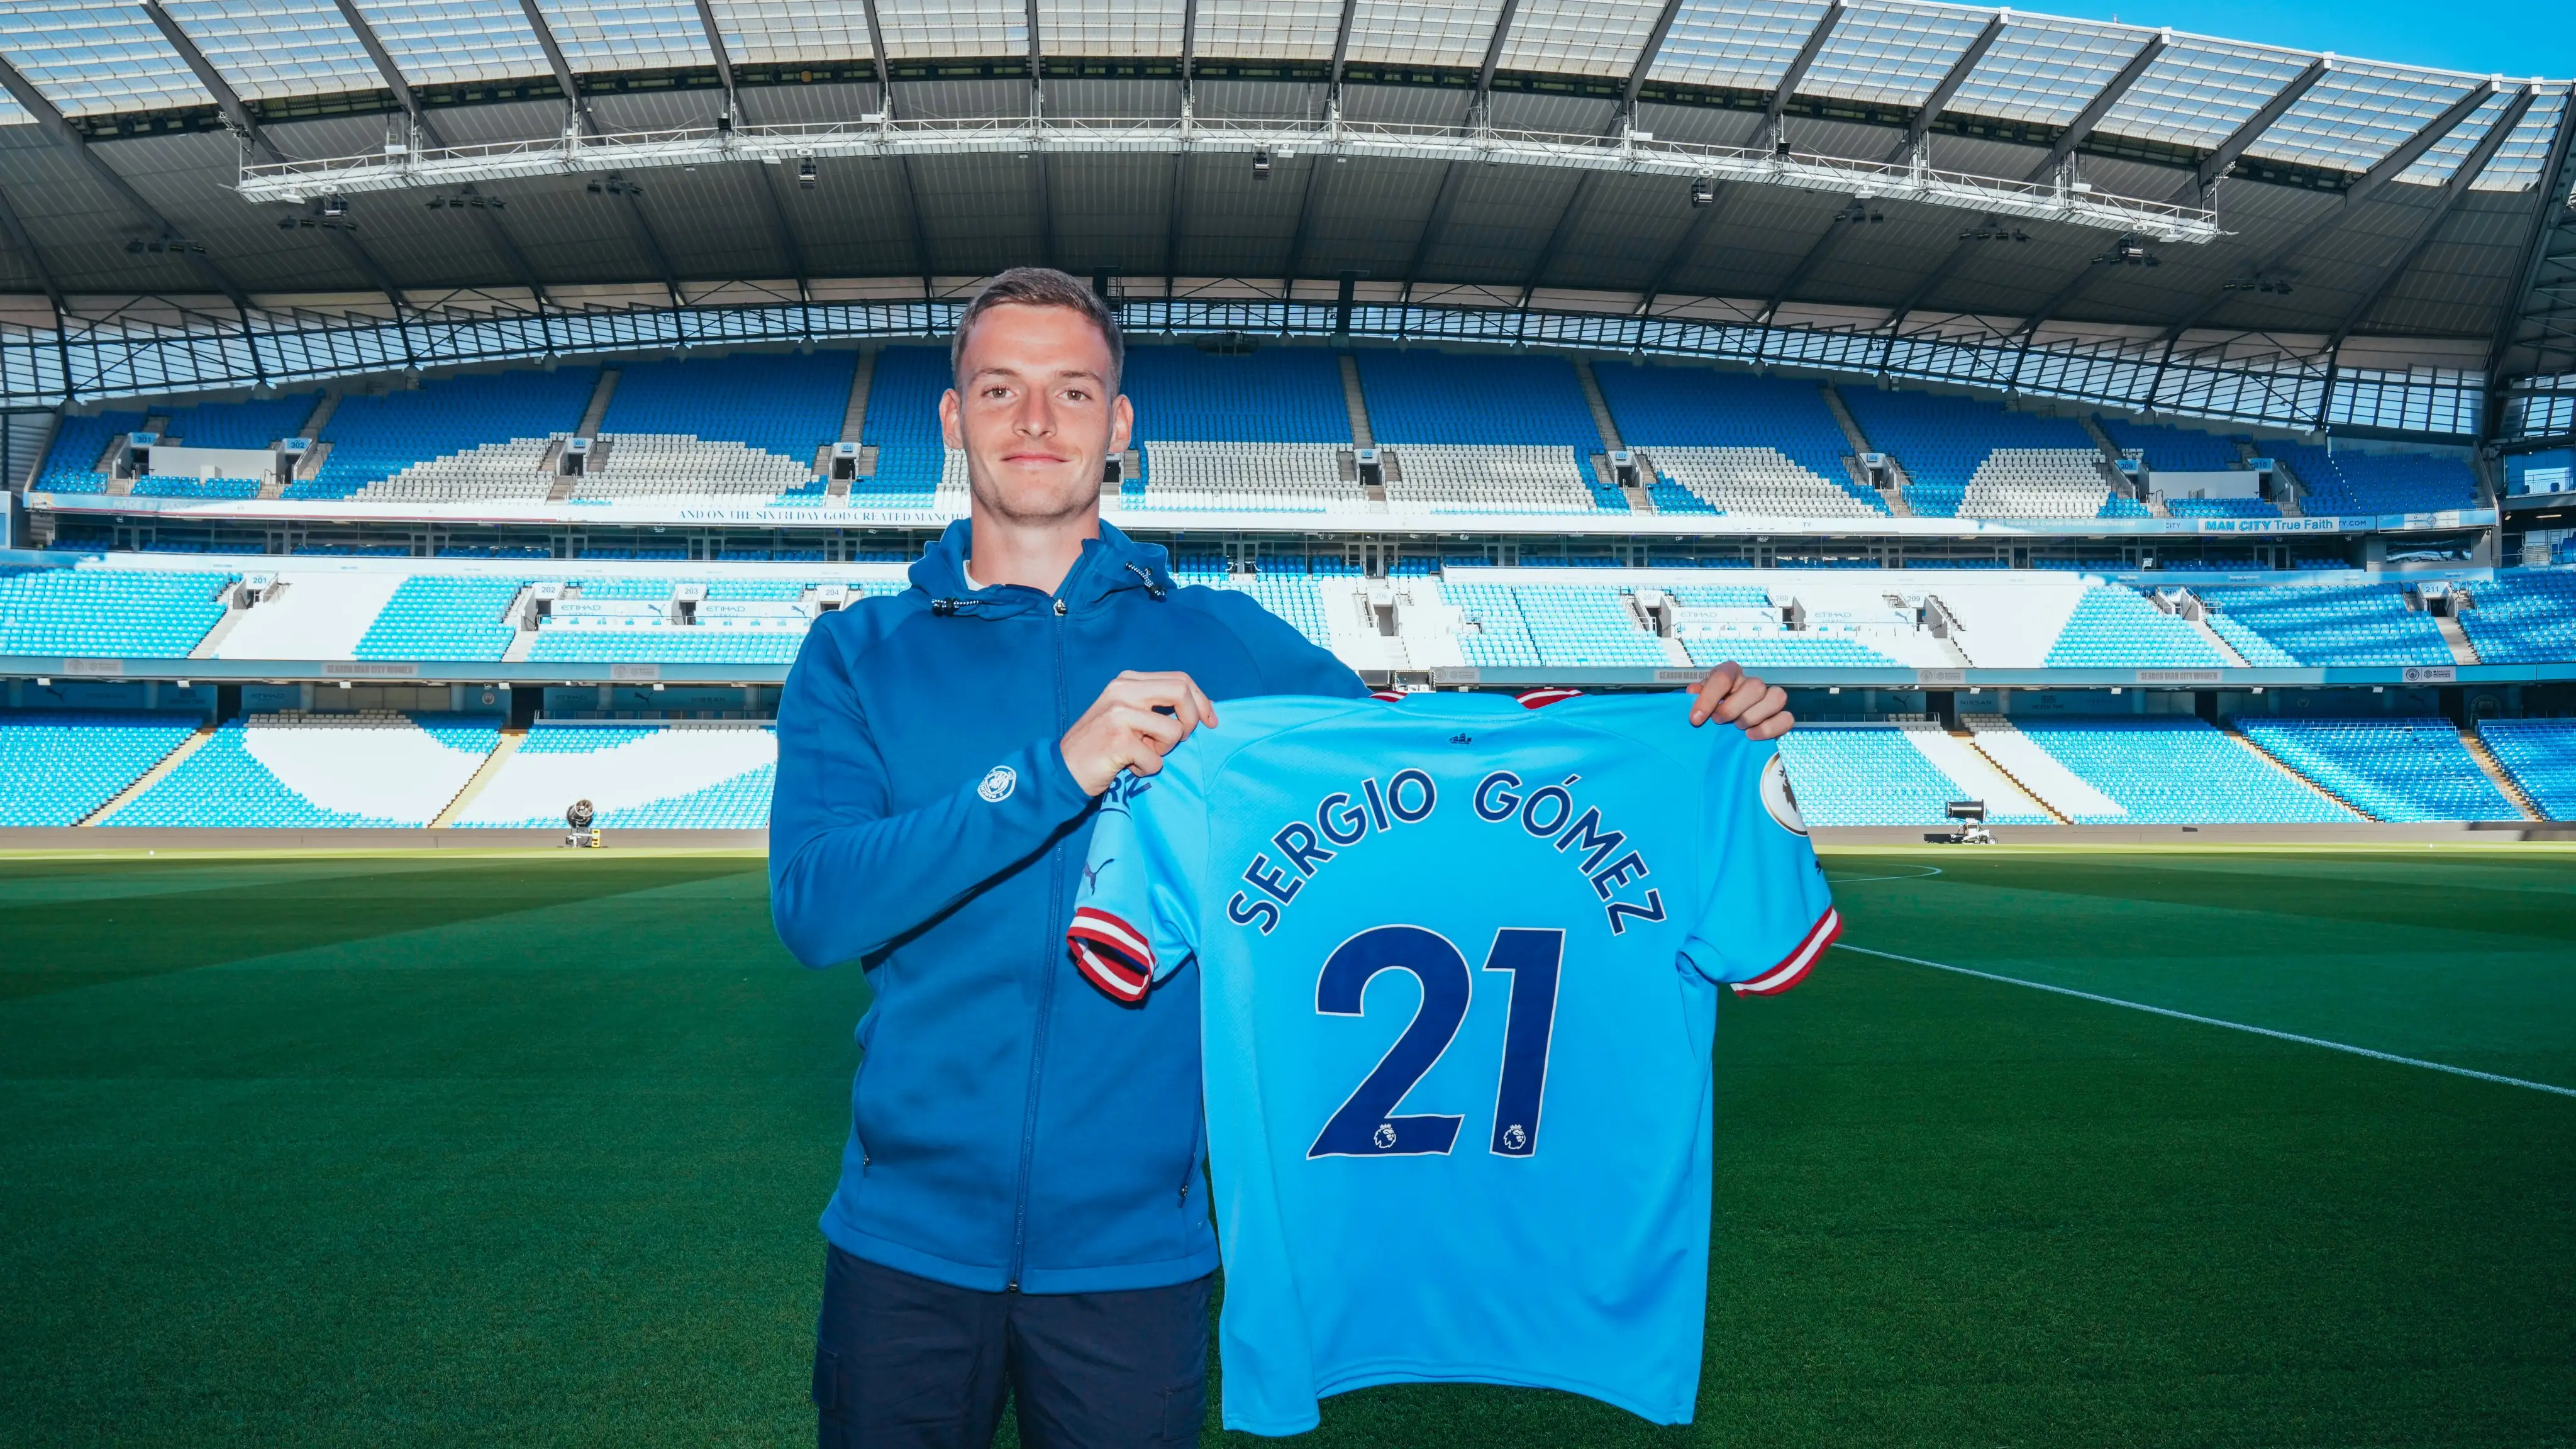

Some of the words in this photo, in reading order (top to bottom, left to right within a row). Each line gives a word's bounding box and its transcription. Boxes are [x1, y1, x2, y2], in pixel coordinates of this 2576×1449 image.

[679, 510, 704, 519] AND
[708, 510, 724, 519] ON
[730, 511, 753, 519] THE
[756, 511, 792, 520] SIXTH
[797, 511, 818, 521] DAY
[824, 512, 850, 521] GOD
[853, 512, 910, 521] CREATED
[2205, 521, 2235, 531] MAN
[2238, 520, 2272, 531] CITY
[2274, 519, 2301, 530] True
[2304, 519, 2333, 530] Faith
[2141, 672, 2163, 680] SEARCH
[2164, 672, 2179, 680] MAN
[2180, 672, 2193, 680] CITY
[2194, 671, 2218, 680] WOMEN
[1226, 768, 1437, 936] SERGIO
[1473, 769, 1667, 936] GÓMEZ
[1306, 923, 1566, 1160] 21
